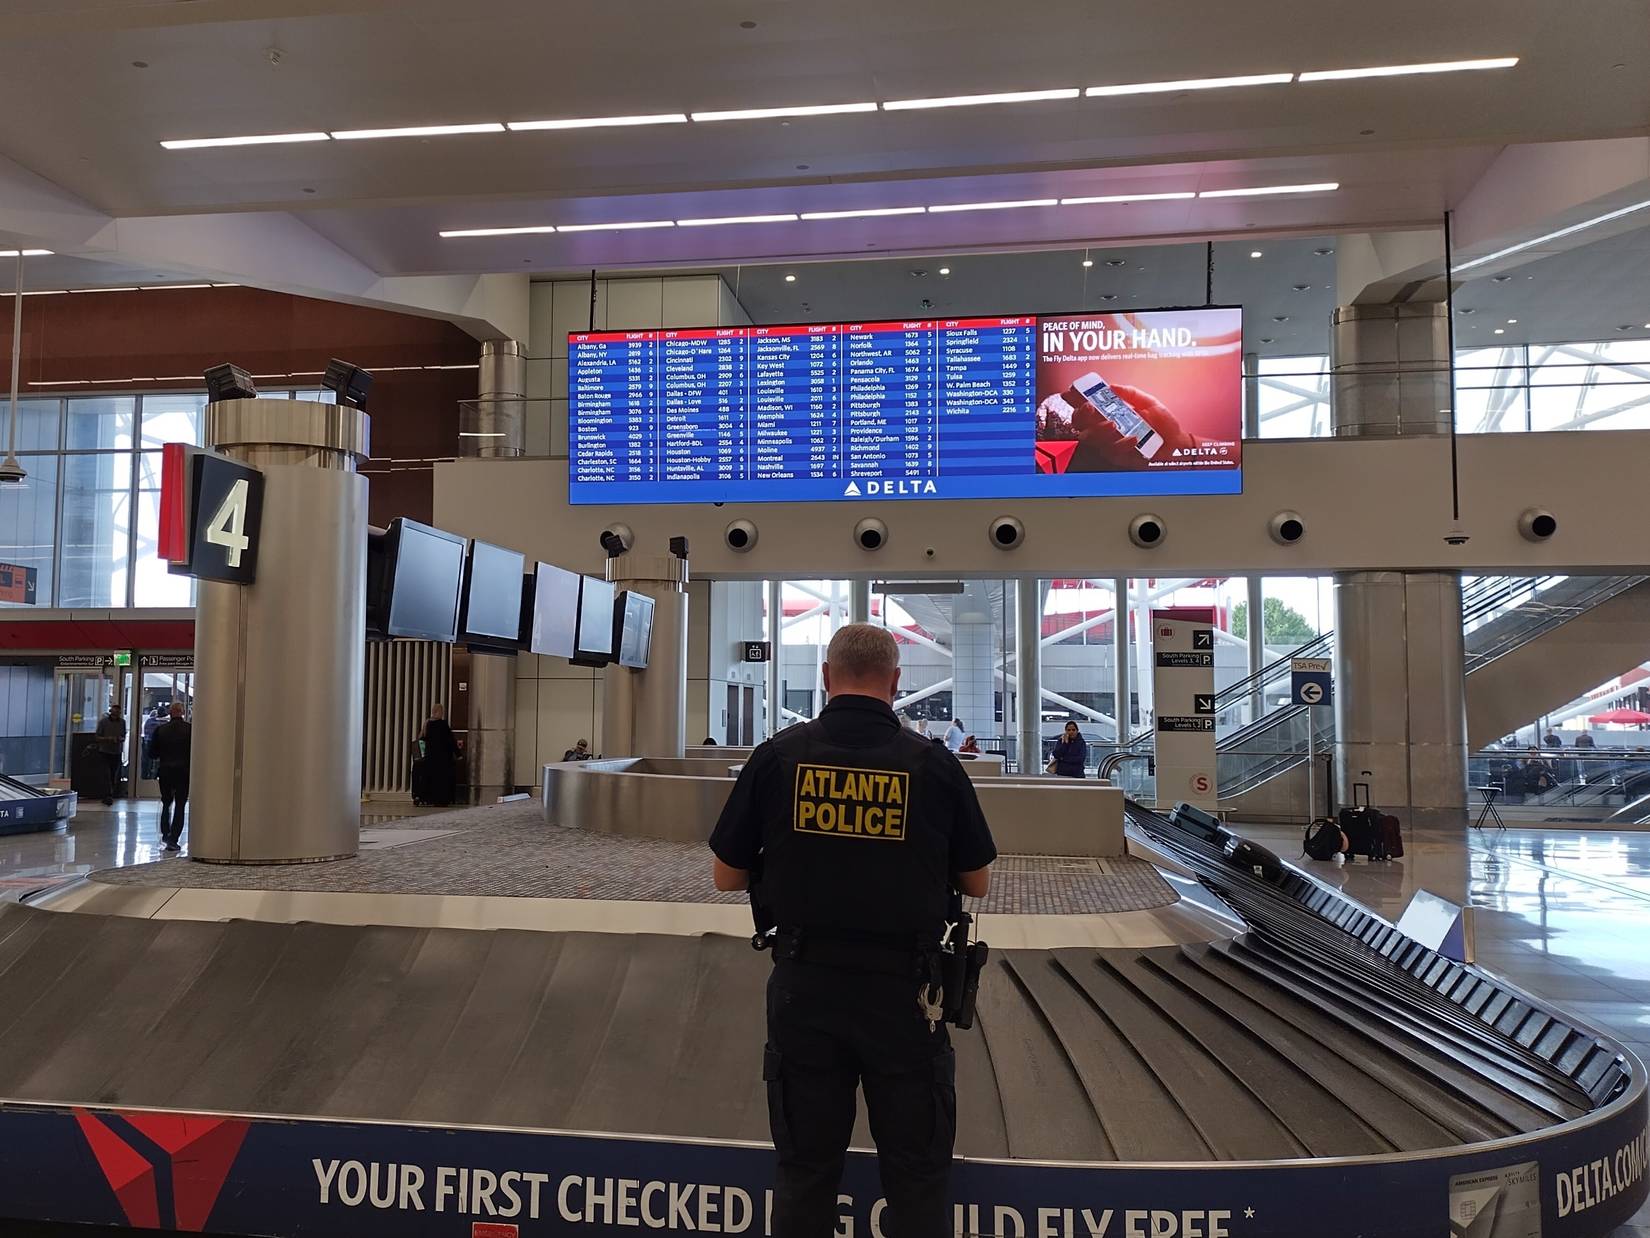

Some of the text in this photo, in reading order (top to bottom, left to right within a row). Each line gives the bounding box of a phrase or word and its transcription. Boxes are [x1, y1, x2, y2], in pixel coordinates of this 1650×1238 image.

[1043, 321, 1105, 331] PEACE OF MIND,
[1043, 328, 1197, 352] IN YOUR HAND.
[868, 481, 936, 493] DELTA
[207, 479, 249, 568] 4
[801, 769, 902, 804] ATLANTA
[1197, 778, 1207, 791] S
[798, 800, 901, 836] POLICE
[312, 1158, 425, 1211] YOUR
[436, 1166, 549, 1219] FIRST
[557, 1174, 753, 1234] CHECKED
